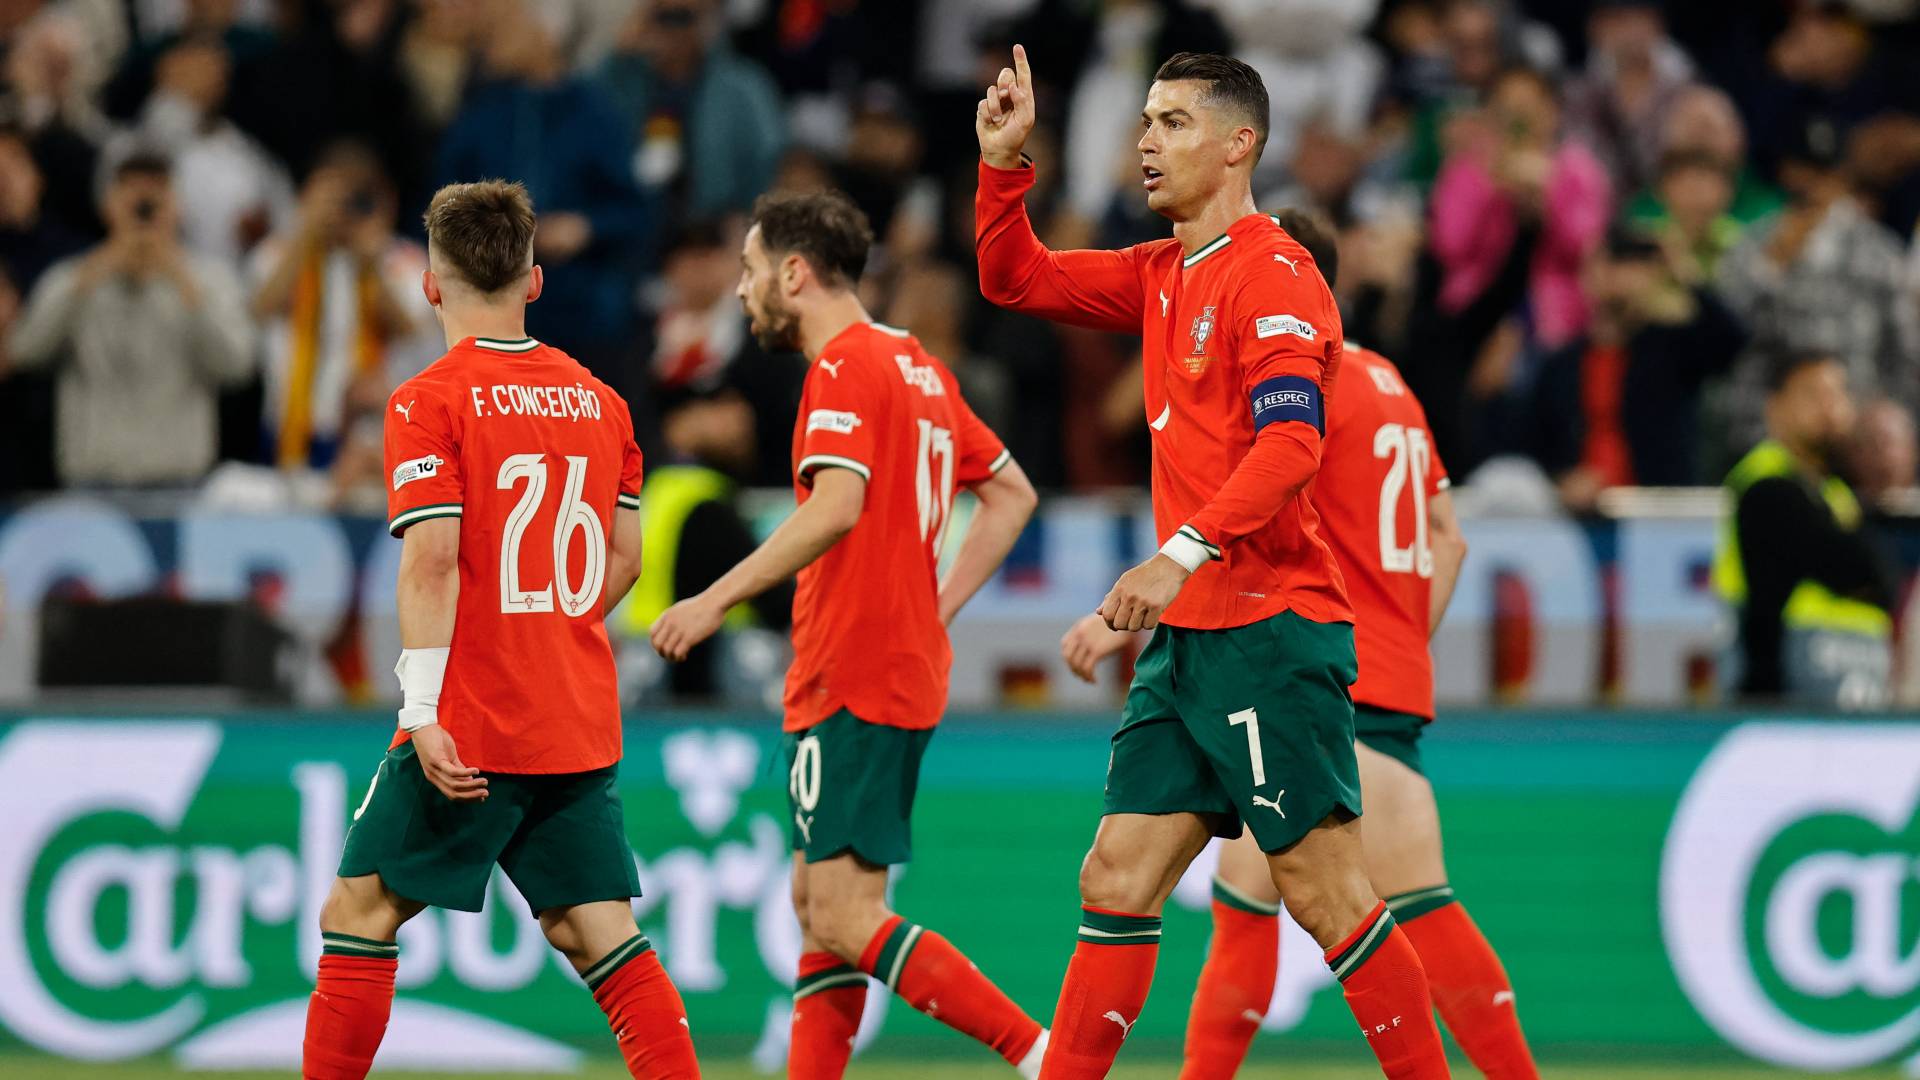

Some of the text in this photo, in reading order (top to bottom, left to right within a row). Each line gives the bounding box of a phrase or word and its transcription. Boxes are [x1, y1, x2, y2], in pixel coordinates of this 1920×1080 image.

[471, 382, 601, 423] F. CONCEIÇÃO
[1264, 393, 1310, 406] RESPECT
[417, 462, 434, 473] 10
[497, 453, 606, 617] 26
[1227, 706, 1266, 787] 7
[0, 717, 886, 1074] Carlr
